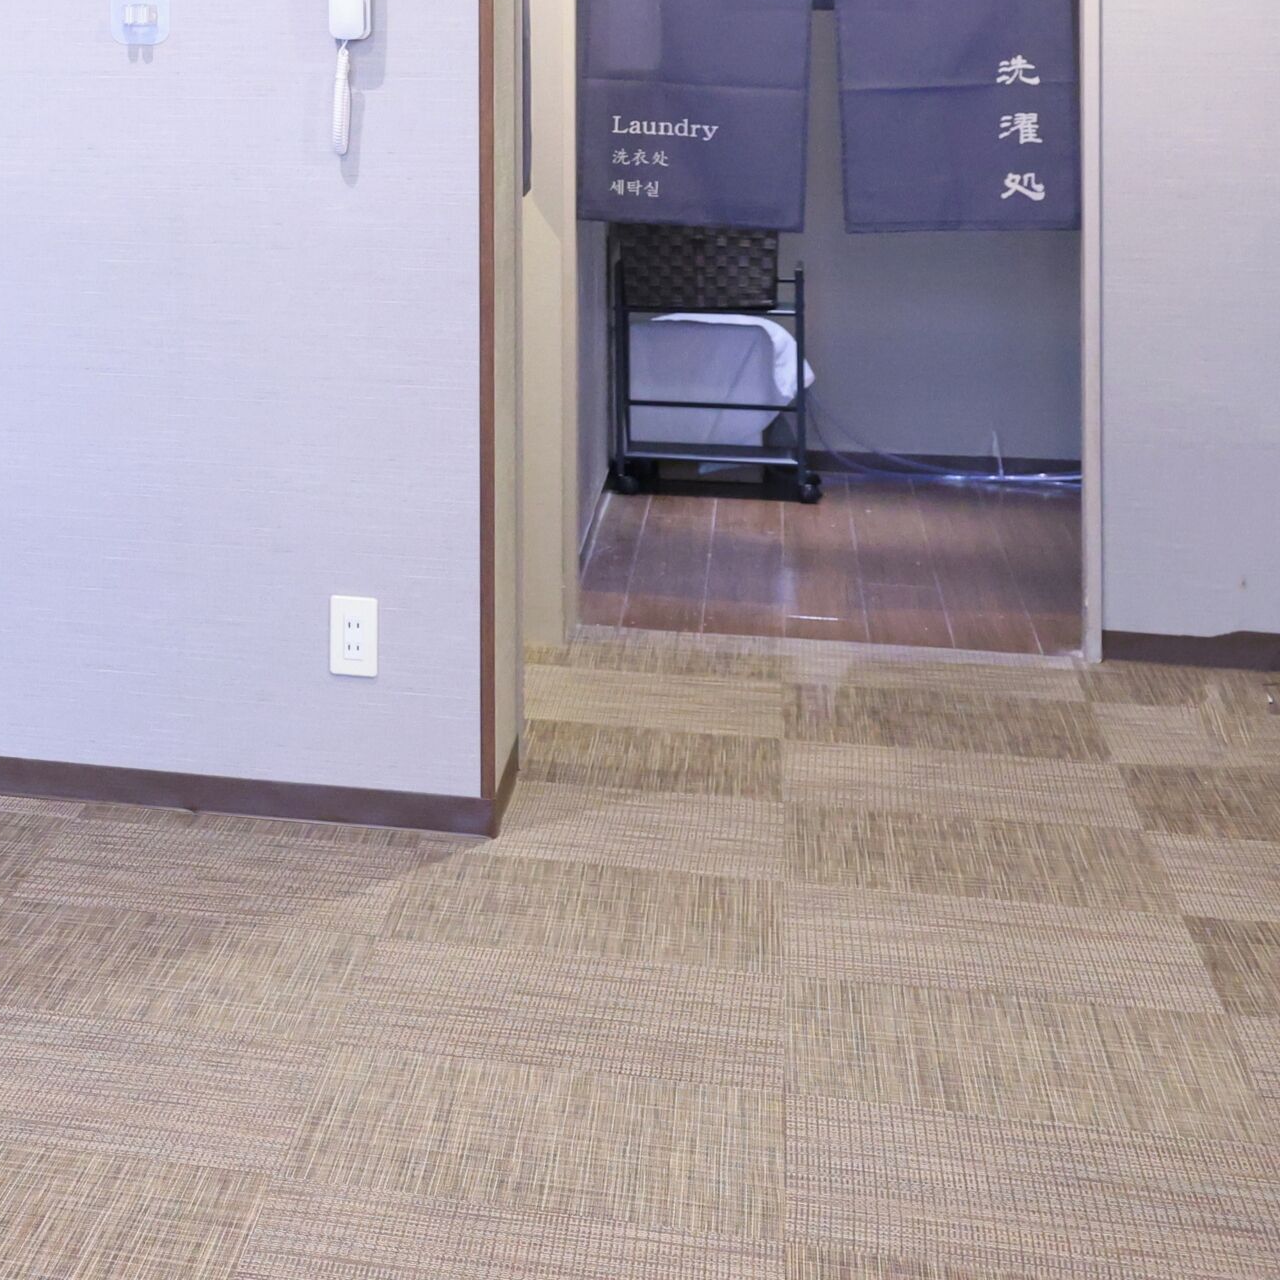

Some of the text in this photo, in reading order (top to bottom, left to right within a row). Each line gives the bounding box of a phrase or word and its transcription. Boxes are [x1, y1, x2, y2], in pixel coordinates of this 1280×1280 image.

[612, 115, 719, 141] Laundry
[996, 54, 1046, 201] 洗濯処
[611, 148, 669, 167] 洗衣处
[609, 179, 660, 198] 세탁실
